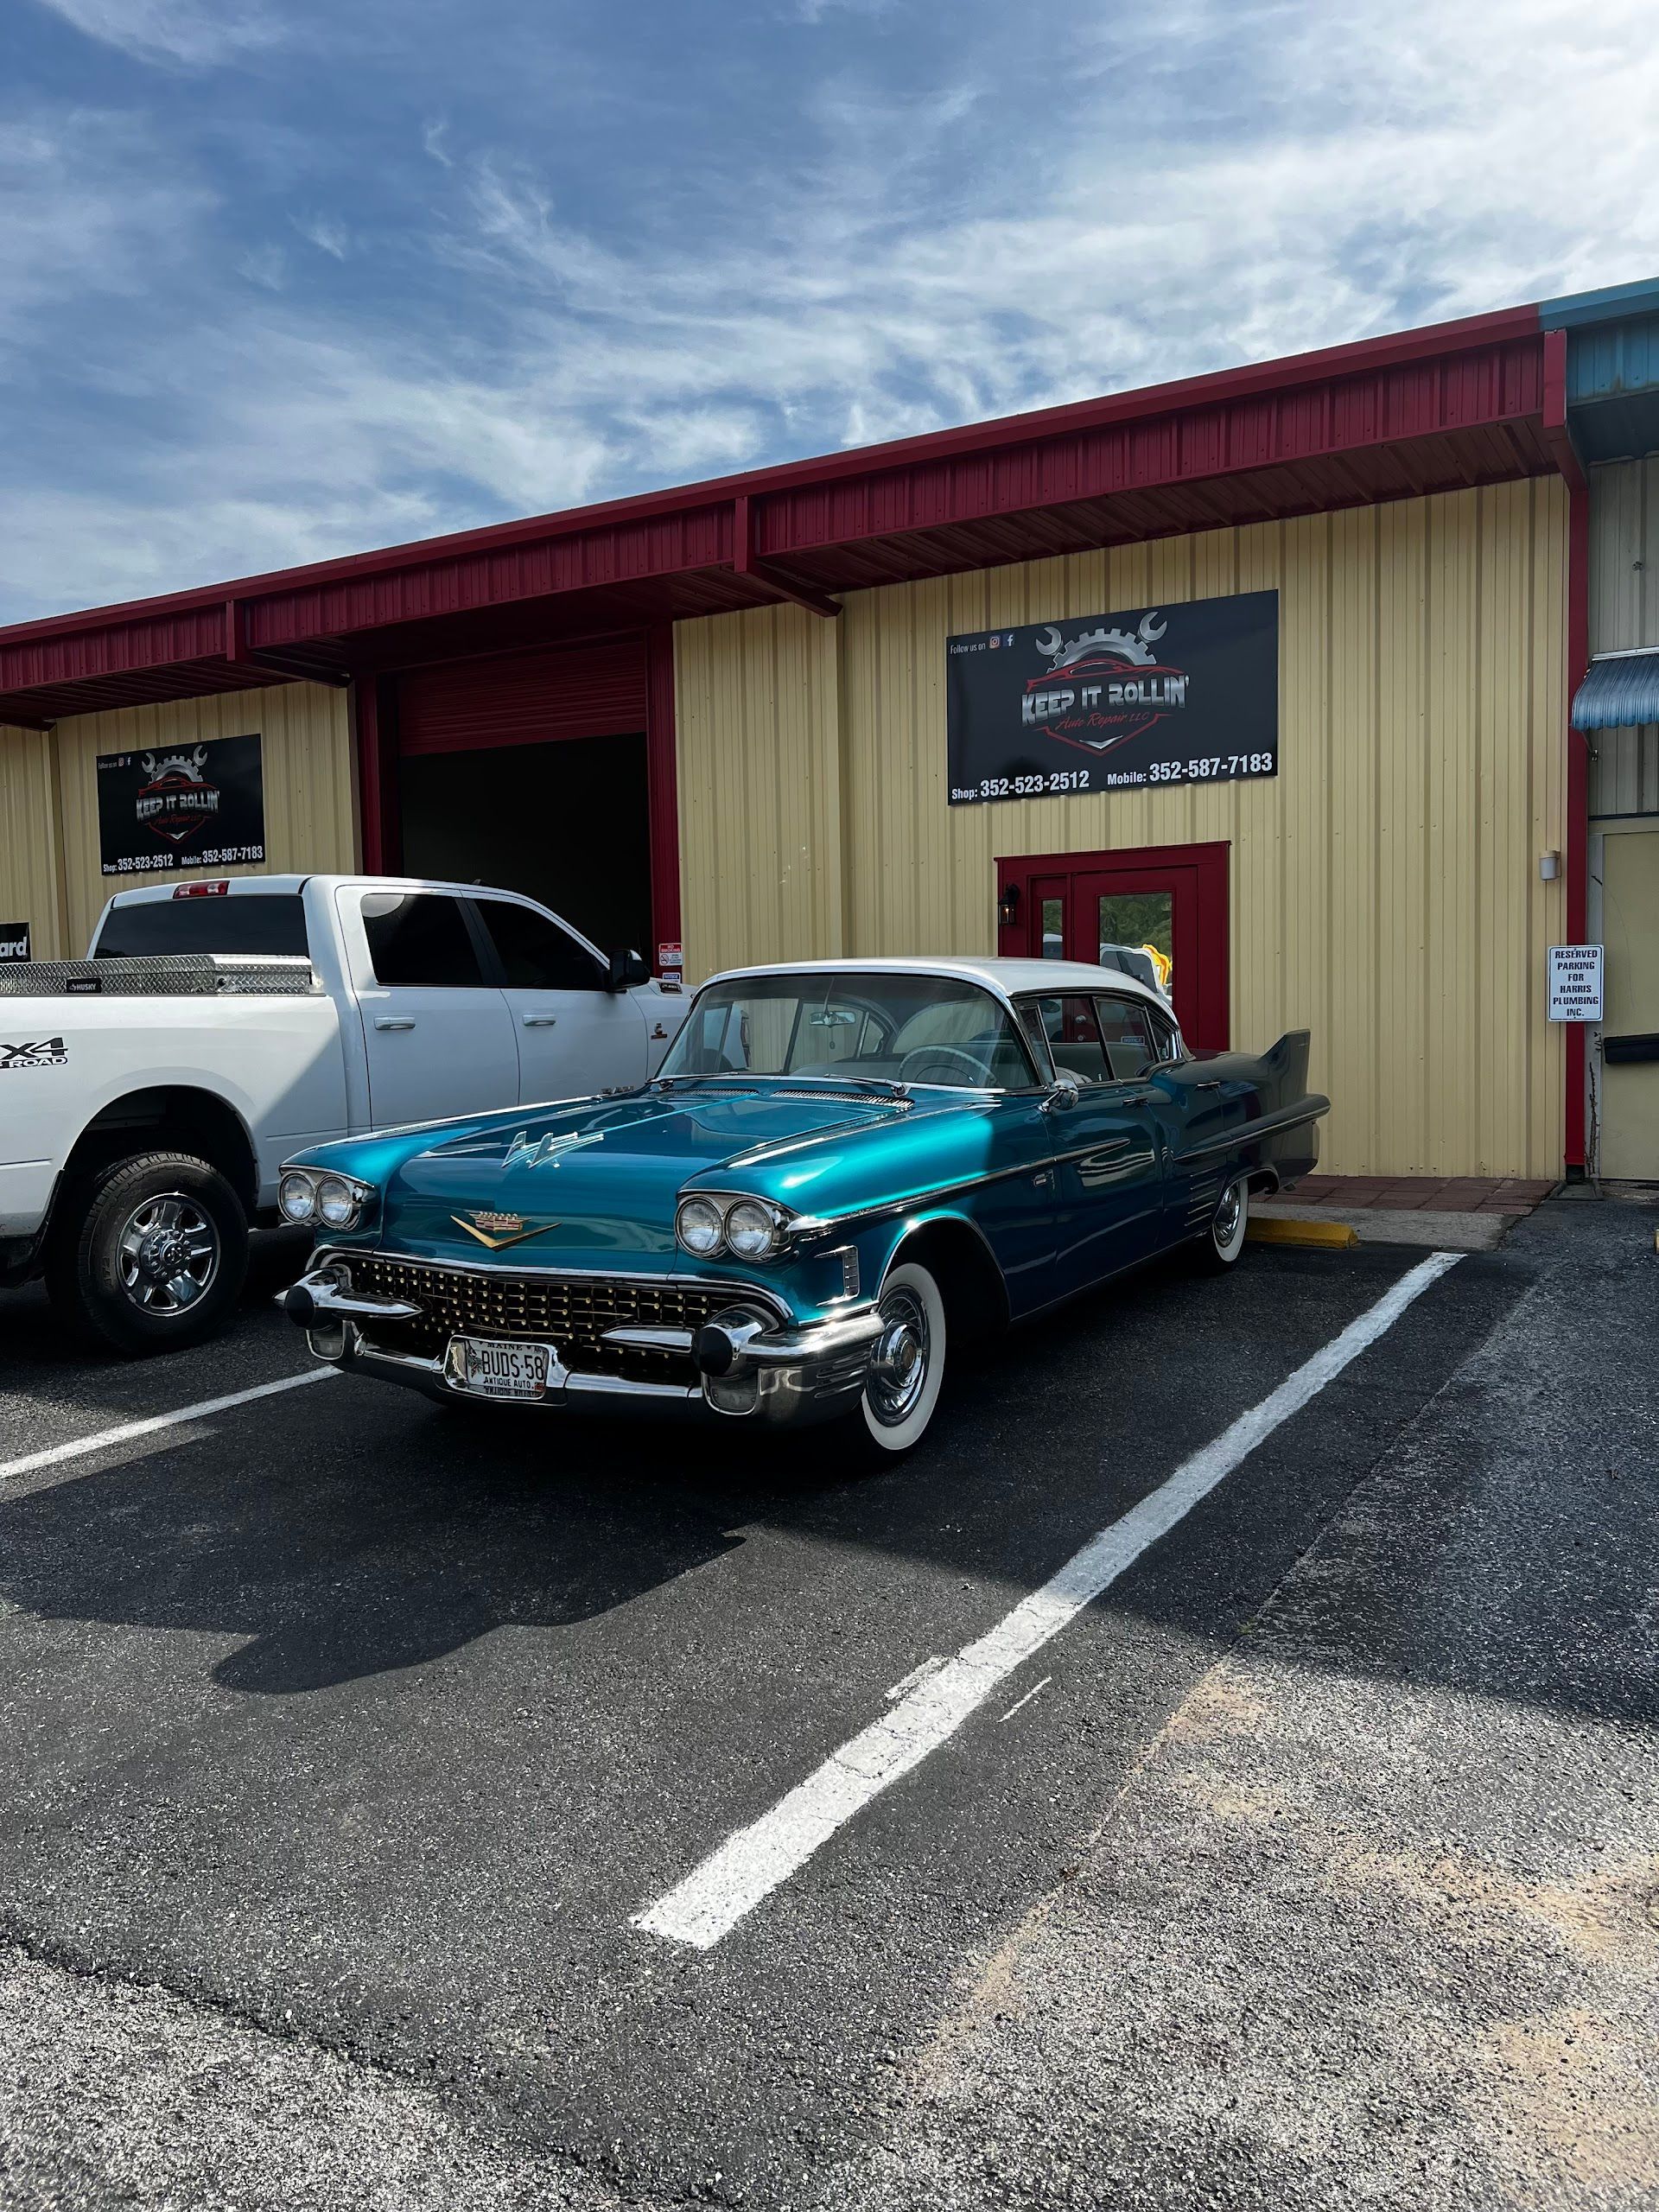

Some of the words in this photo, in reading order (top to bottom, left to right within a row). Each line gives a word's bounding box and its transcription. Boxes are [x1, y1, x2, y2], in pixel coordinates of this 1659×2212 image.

[950, 645, 968, 654] Follow
[1021, 689, 1075, 727] KEEP
[1082, 685, 1102, 710] IT
[1109, 675, 1189, 708] ROLLIN'
[1055, 715, 1085, 731] Auto
[1087, 712, 1128, 728] Repair
[1128, 712, 1150, 722] LLC
[951, 788, 978, 800] Shop:
[980, 770, 1090, 797] 352-523-2512
[1107, 772, 1147, 785] Mobile:
[1149, 753, 1273, 782] 352-587-7183
[136, 797, 162, 820] KEEP
[166, 794, 177, 810] IT
[103, 864, 118, 874] Shop:
[118, 854, 173, 871] 352-523-2512
[181, 855, 202, 866] Mobile:
[202, 845, 263, 863] 352-587-7183
[1555, 950, 1598, 958] RESERVED
[1567, 973, 1584, 982] FOR
[77, 982, 96, 991] HUSKY
[1553, 996, 1599, 1005] PLUMBING
[9, 1057, 67, 1068] ROAD
[484, 1376, 512, 1387] ANTIQUE
